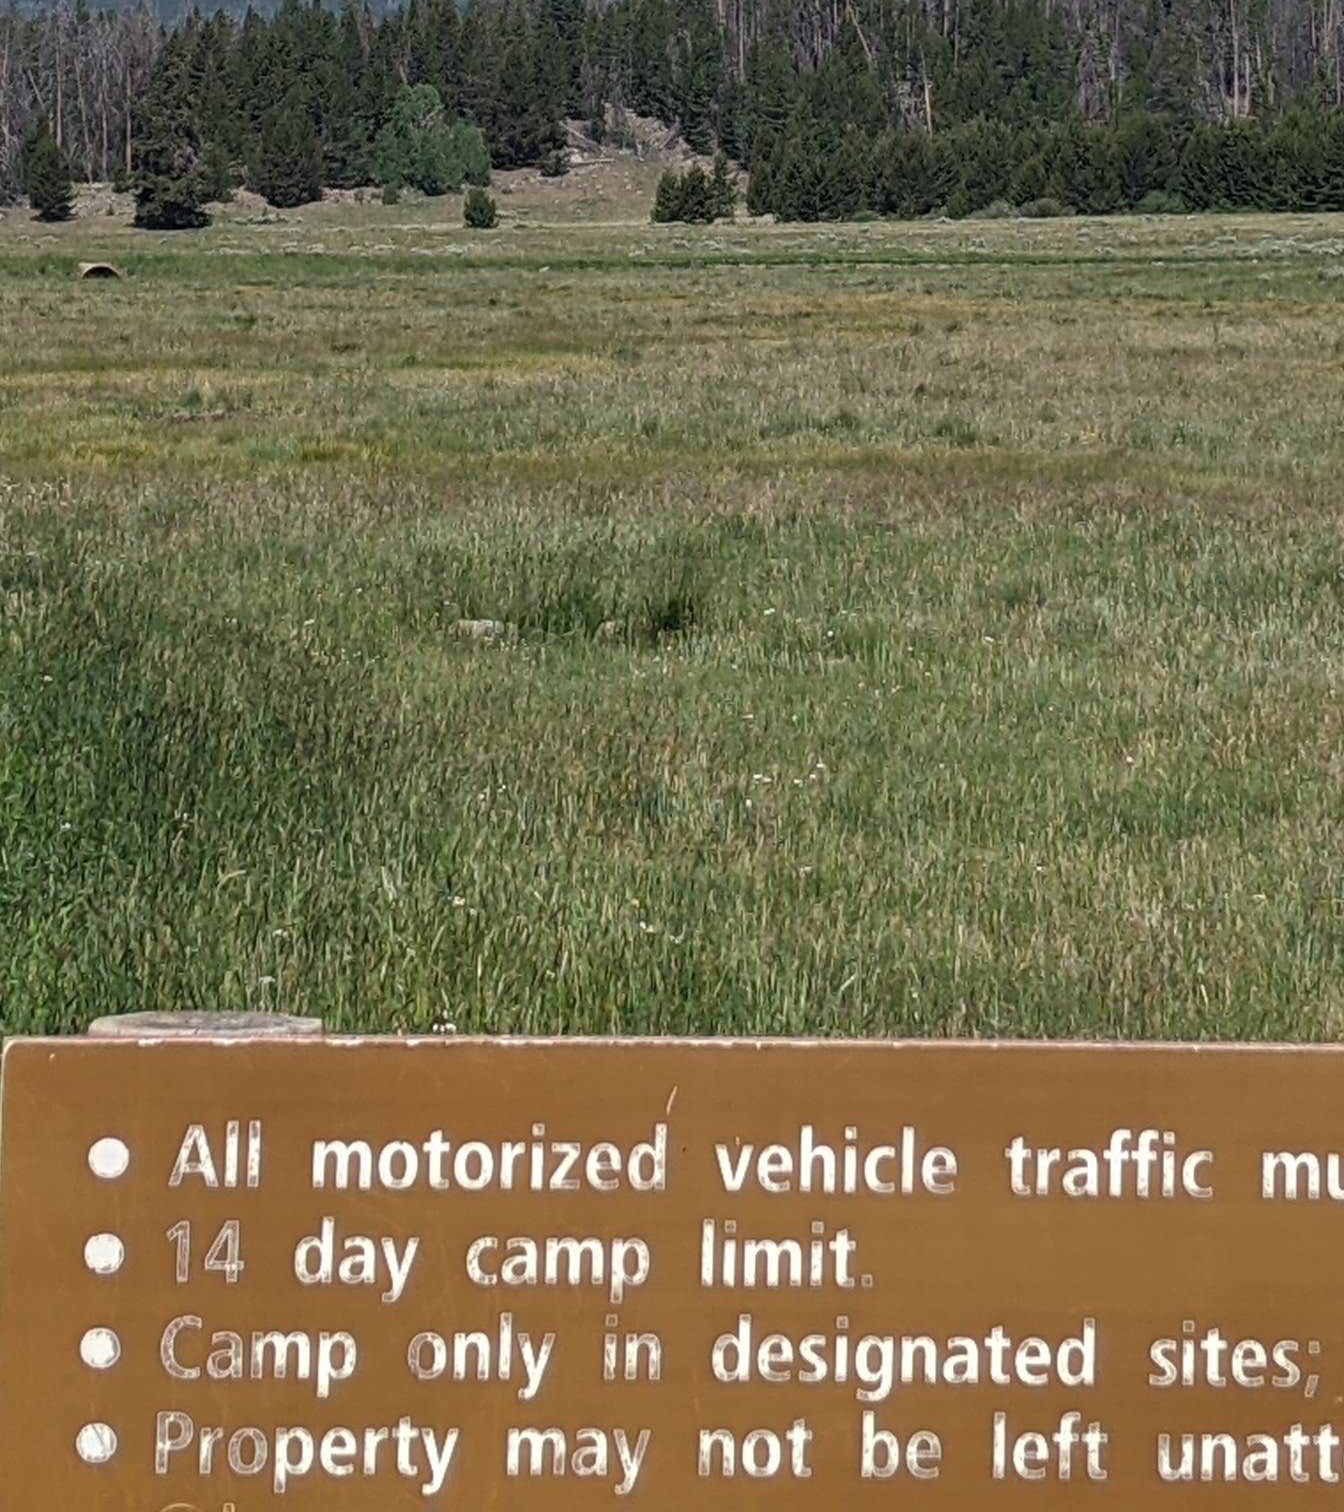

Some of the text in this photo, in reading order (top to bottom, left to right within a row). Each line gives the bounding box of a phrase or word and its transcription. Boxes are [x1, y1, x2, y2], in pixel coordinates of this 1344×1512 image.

[168, 1120, 262, 1188] All
[312, 1123, 668, 1190] motorized
[715, 1125, 957, 1194] vehicle
[1005, 1129, 1214, 1197] traffic
[166, 1217, 873, 1303] 14 day camp limit.
[160, 1314, 357, 1397] Camp
[407, 1312, 555, 1399] only
[604, 1314, 662, 1380] in
[711, 1314, 1096, 1401] designated
[1148, 1320, 1321, 1397] sites;
[155, 1410, 458, 1494] Property
[506, 1426, 651, 1494] may
[698, 1417, 813, 1478] not
[861, 1410, 942, 1479] be
[992, 1411, 1108, 1480] left
